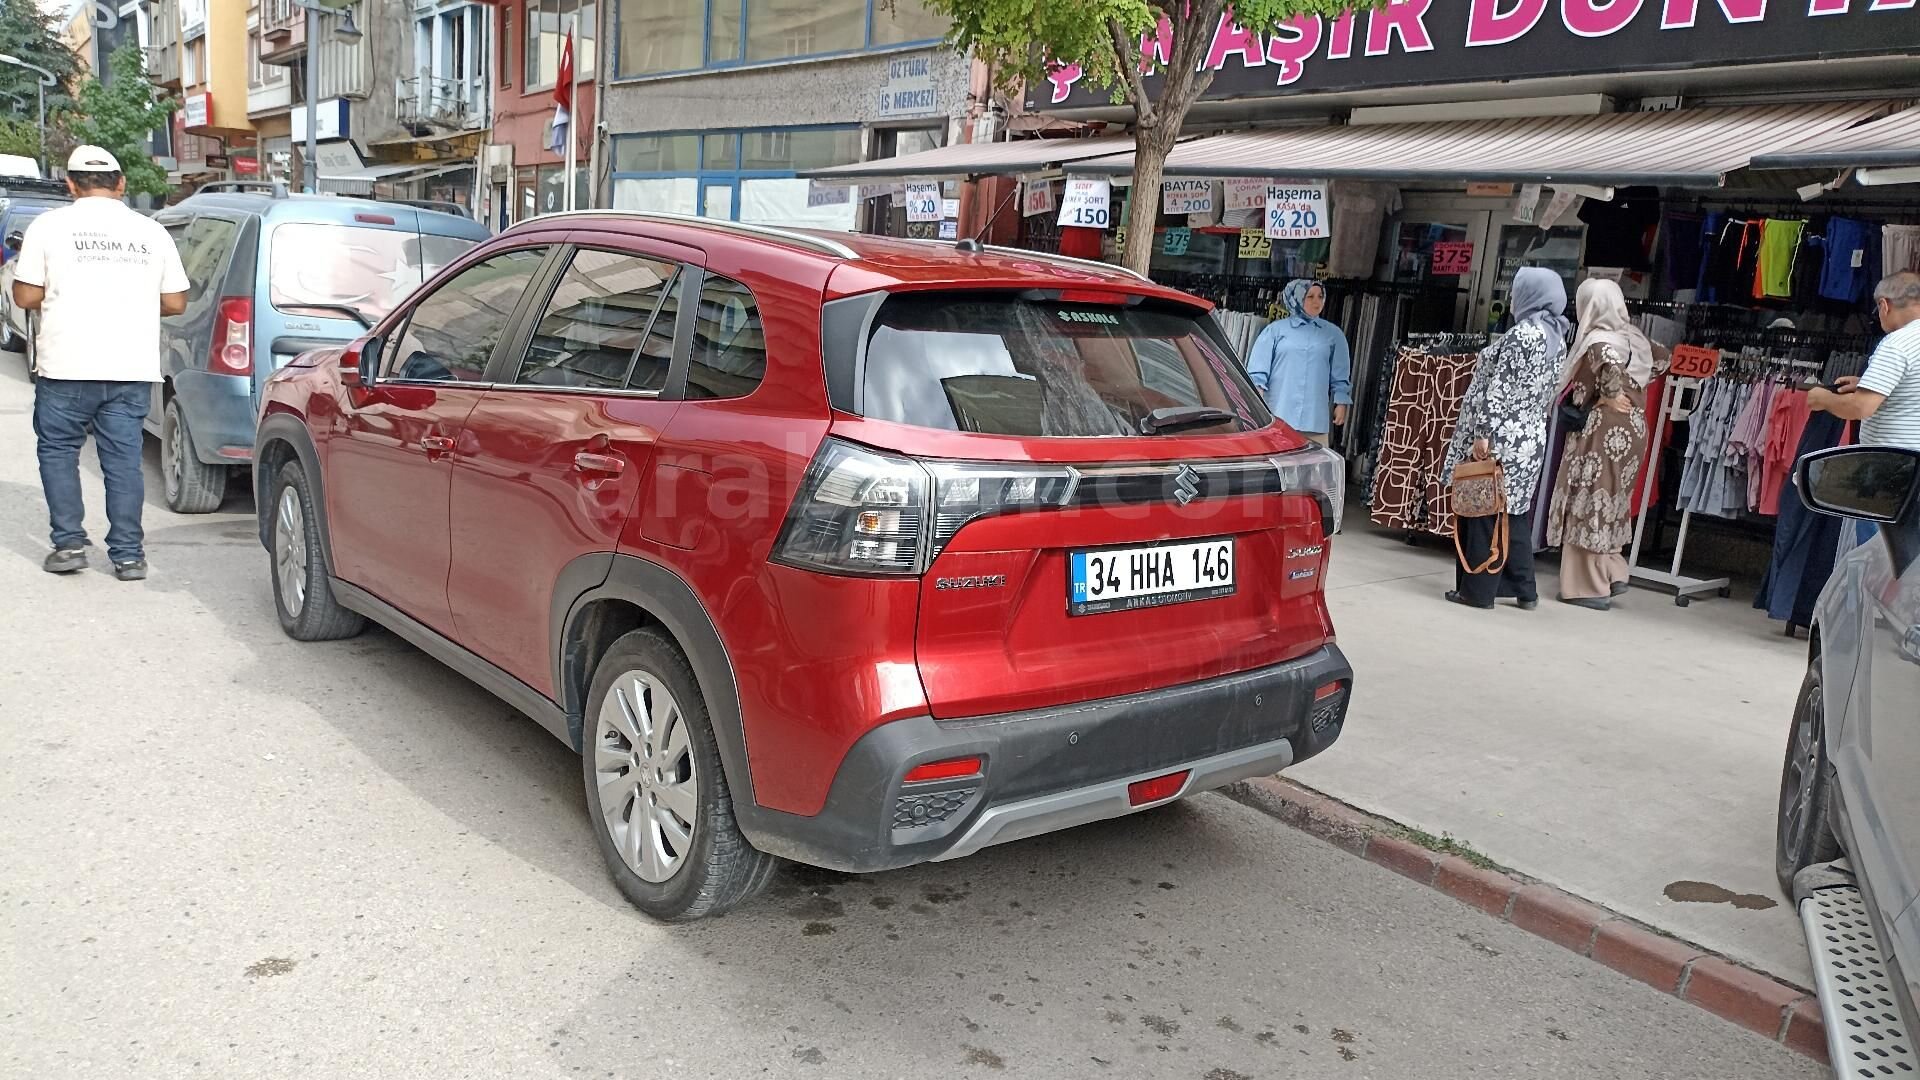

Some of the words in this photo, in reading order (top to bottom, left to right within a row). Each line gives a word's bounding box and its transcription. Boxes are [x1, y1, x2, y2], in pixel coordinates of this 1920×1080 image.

[890, 56, 929, 79] ÖZTÜRK
[906, 183, 937, 194] Haşema
[1164, 181, 1211, 192] BAYTAŞ
[1267, 186, 1322, 203] Haşema
[920, 200, 936, 213] 20
[1184, 199, 1211, 212] 200
[1276, 203, 1297, 211] KASA
[1074, 207, 1108, 225] 150
[1290, 210, 1318, 228] 20
[1269, 228, 1320, 237] İNDİRİM
[1239, 235, 1271, 249] 375
[1433, 249, 1471, 264] 375
[1673, 354, 1713, 375] 250
[1090, 557, 1121, 595] 34
[1130, 551, 1175, 591] HHA
[1192, 545, 1229, 583] 146
[1073, 582, 1087, 594] TR
